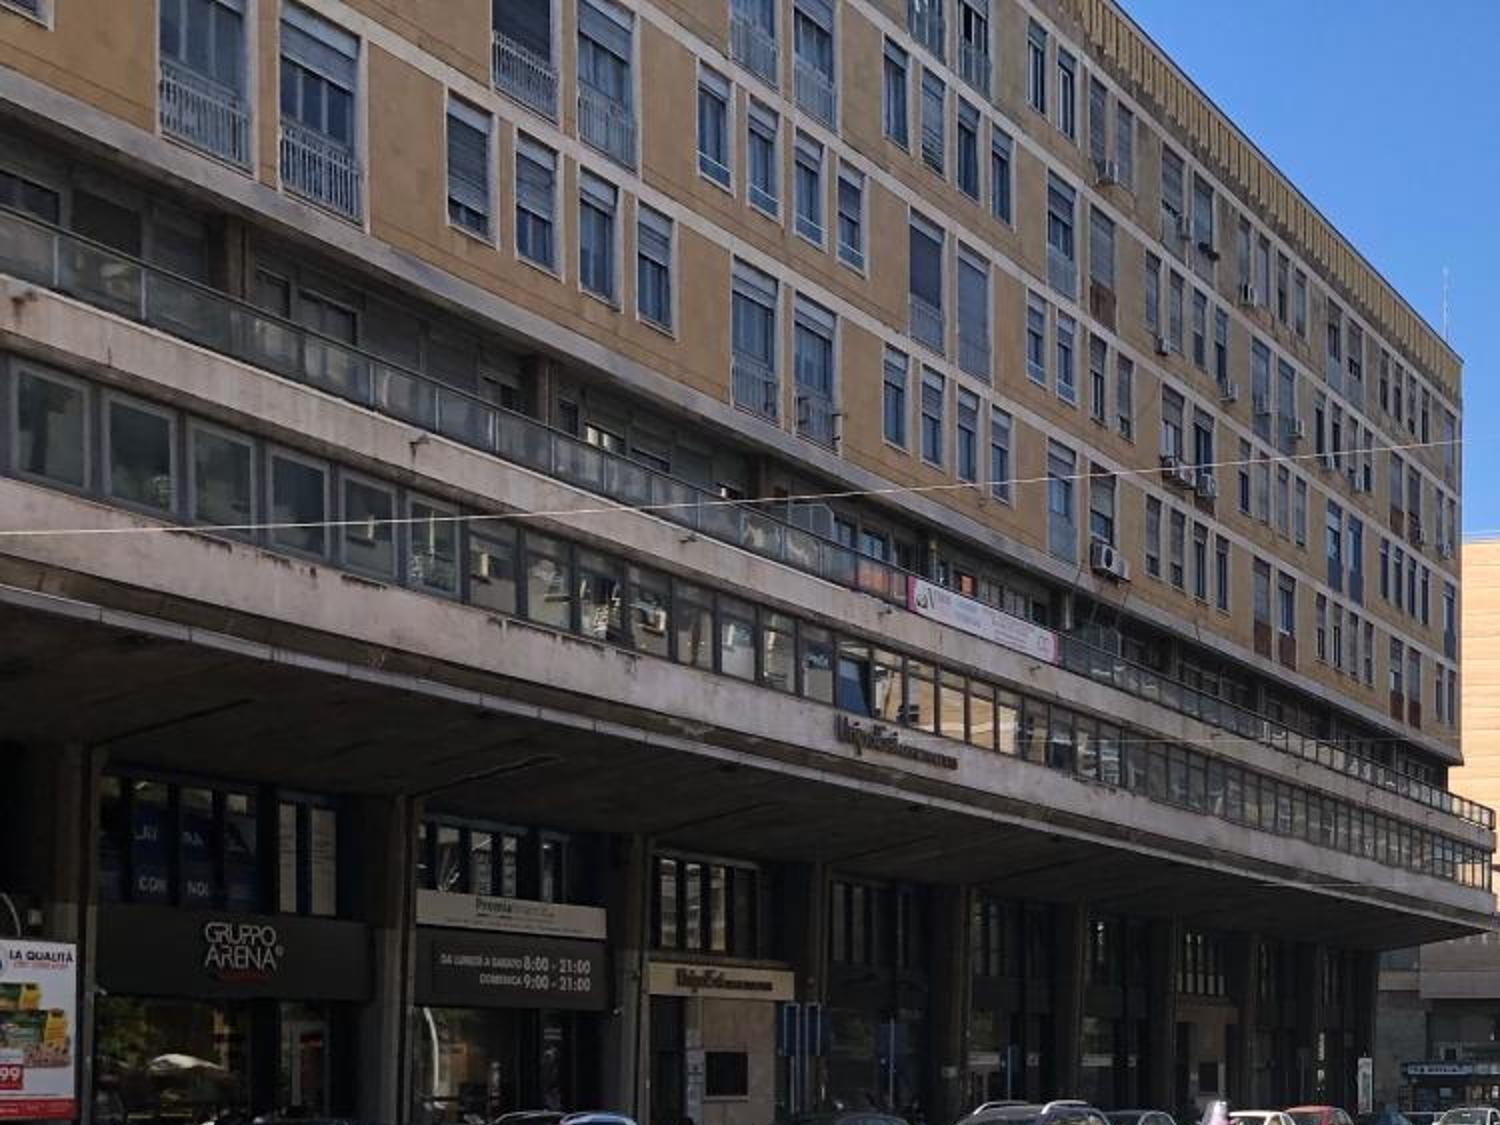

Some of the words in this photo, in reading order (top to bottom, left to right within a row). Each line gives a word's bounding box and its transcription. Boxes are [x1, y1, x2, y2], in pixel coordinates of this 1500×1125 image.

[204, 921, 278, 947] GRUPPO
[9, 949, 23, 961] LA
[523, 955, 549, 972] 8:00
[559, 959, 592, 975] 21:00
[523, 974, 549, 991] 9:00
[559, 976, 592, 993] 21:00
